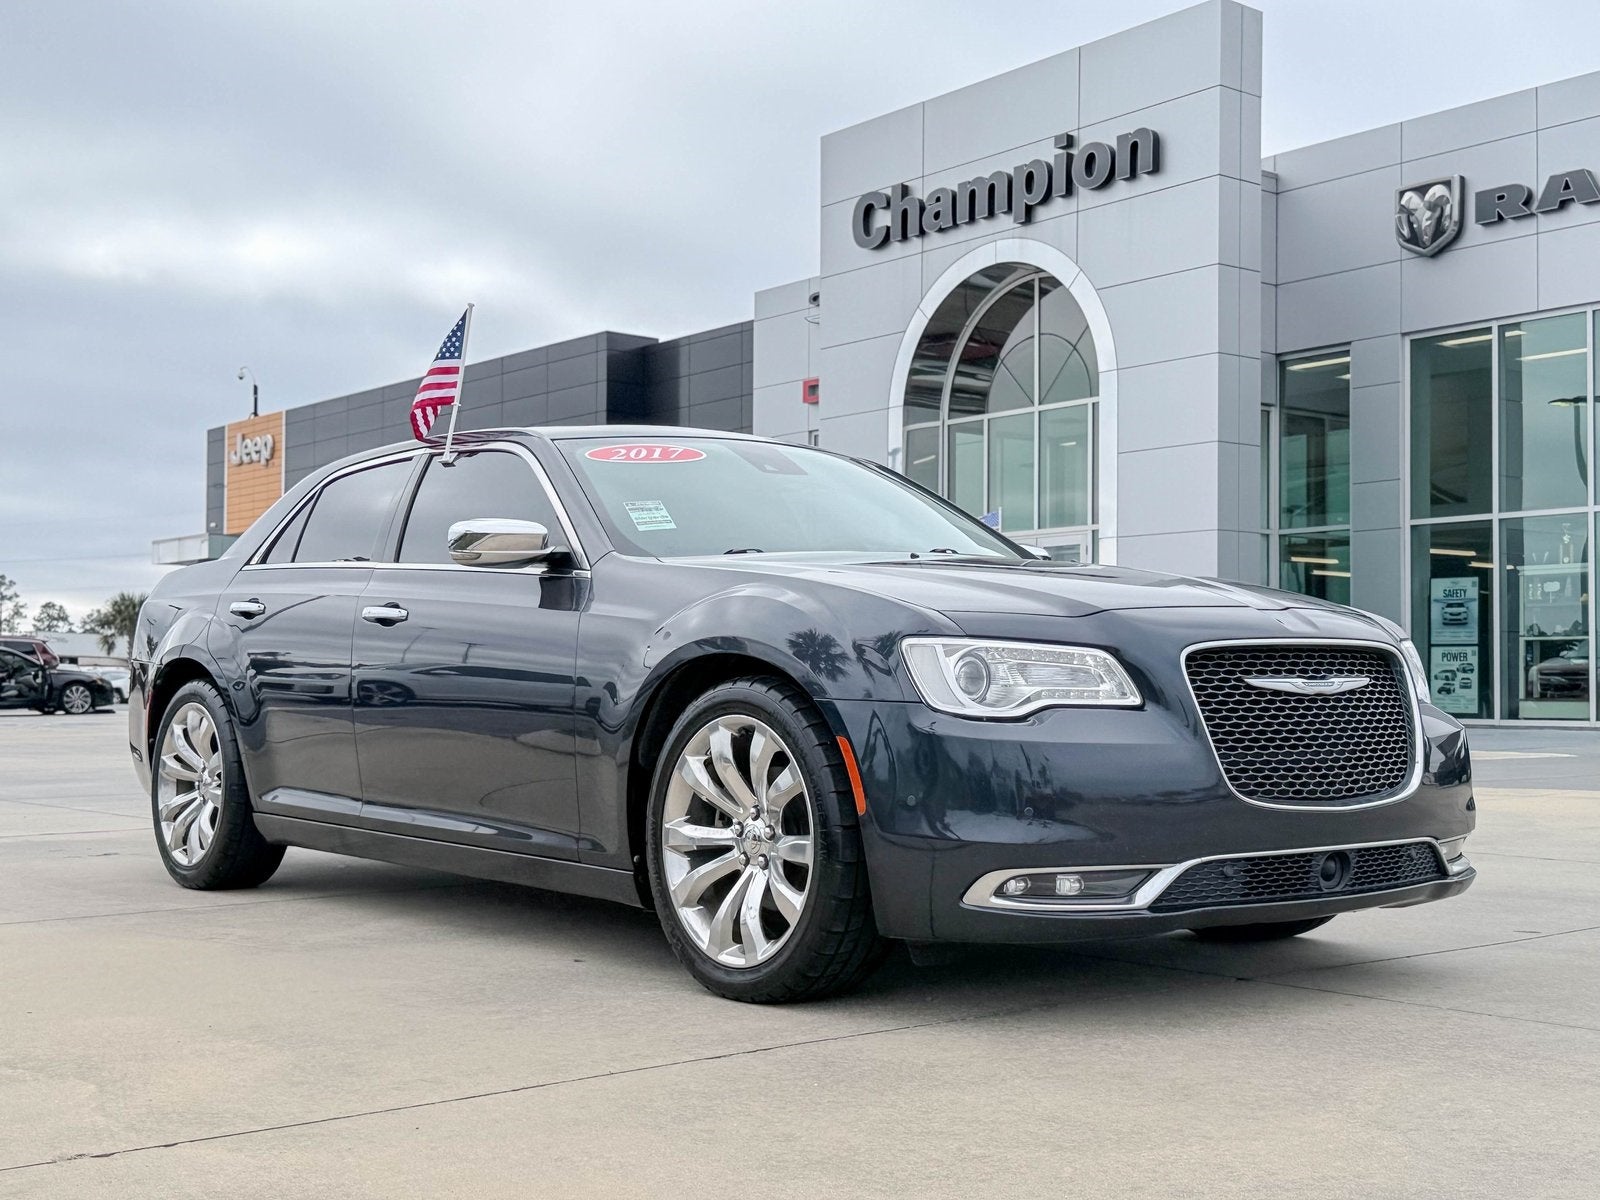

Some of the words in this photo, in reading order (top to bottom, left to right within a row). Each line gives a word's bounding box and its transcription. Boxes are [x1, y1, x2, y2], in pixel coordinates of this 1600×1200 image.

[852, 127, 1159, 249] Champion
[230, 433, 275, 467] Jeep
[609, 447, 684, 460] 2017
[1442, 588, 1468, 598] SAFETY
[1441, 652, 1468, 662] POWER
